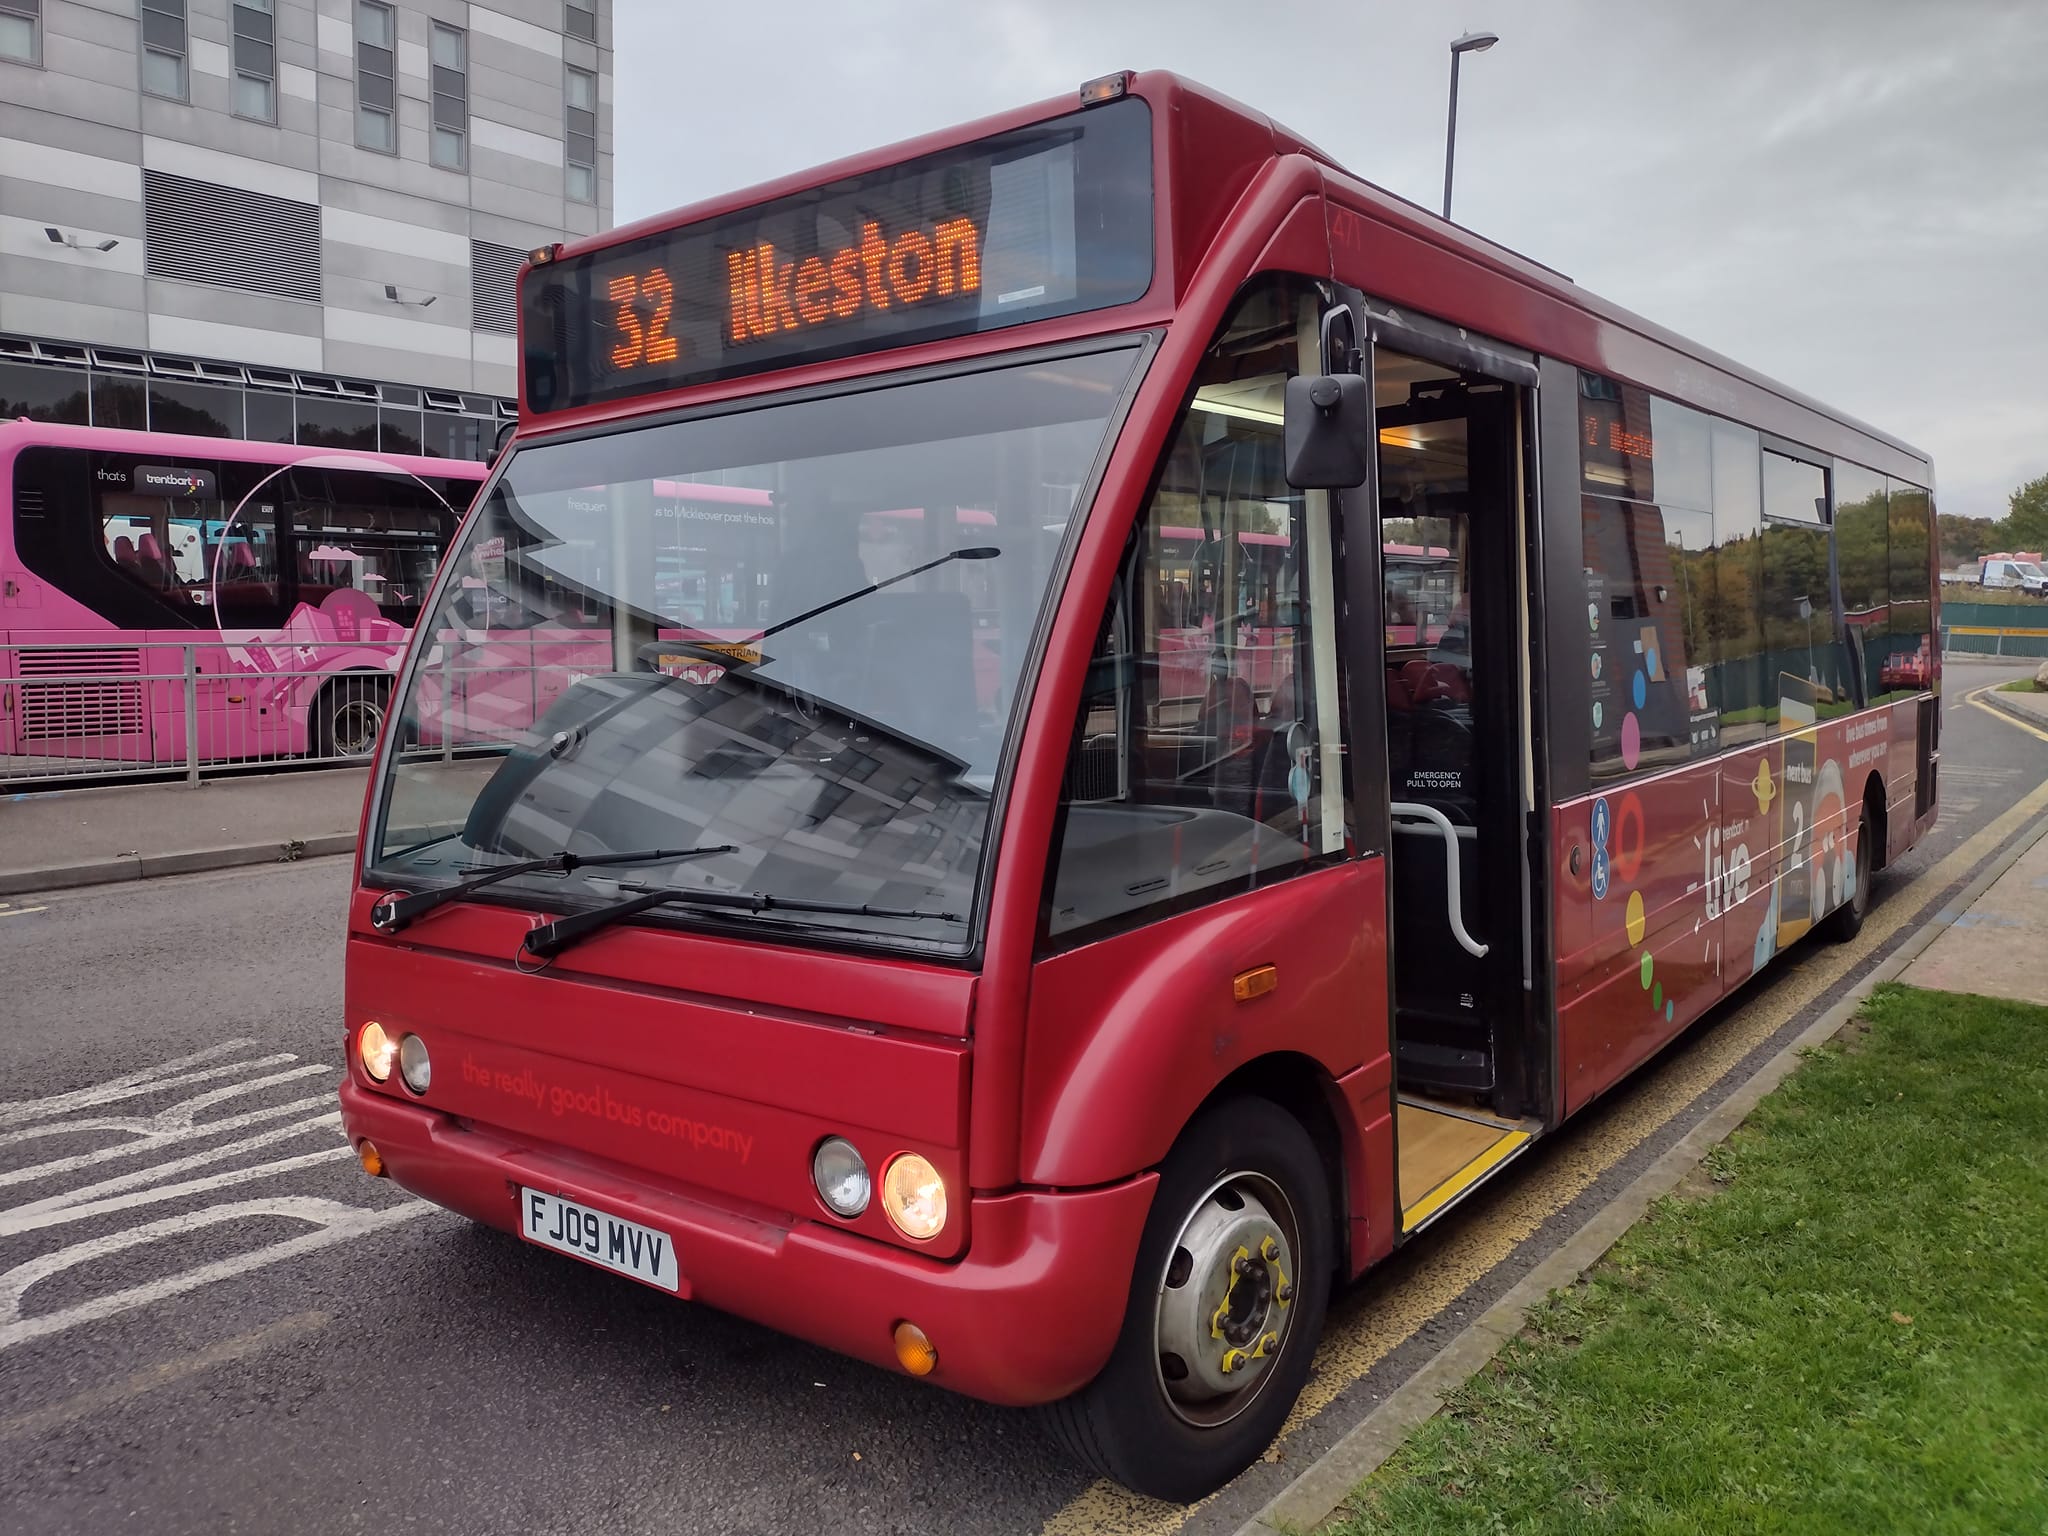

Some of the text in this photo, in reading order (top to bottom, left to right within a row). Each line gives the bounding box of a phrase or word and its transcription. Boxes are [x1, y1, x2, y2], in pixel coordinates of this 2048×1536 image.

[608, 217, 980, 368] 32 Ilkeston
[1406, 779, 1462, 788] PULL TO OPEN
[1414, 771, 1461, 780] EMERGENCY
[1786, 761, 1812, 784] next bus
[1790, 801, 1804, 868] 2
[462, 1054, 752, 1165] the really good bus company
[531, 1194, 662, 1277] FJ09 MVV
